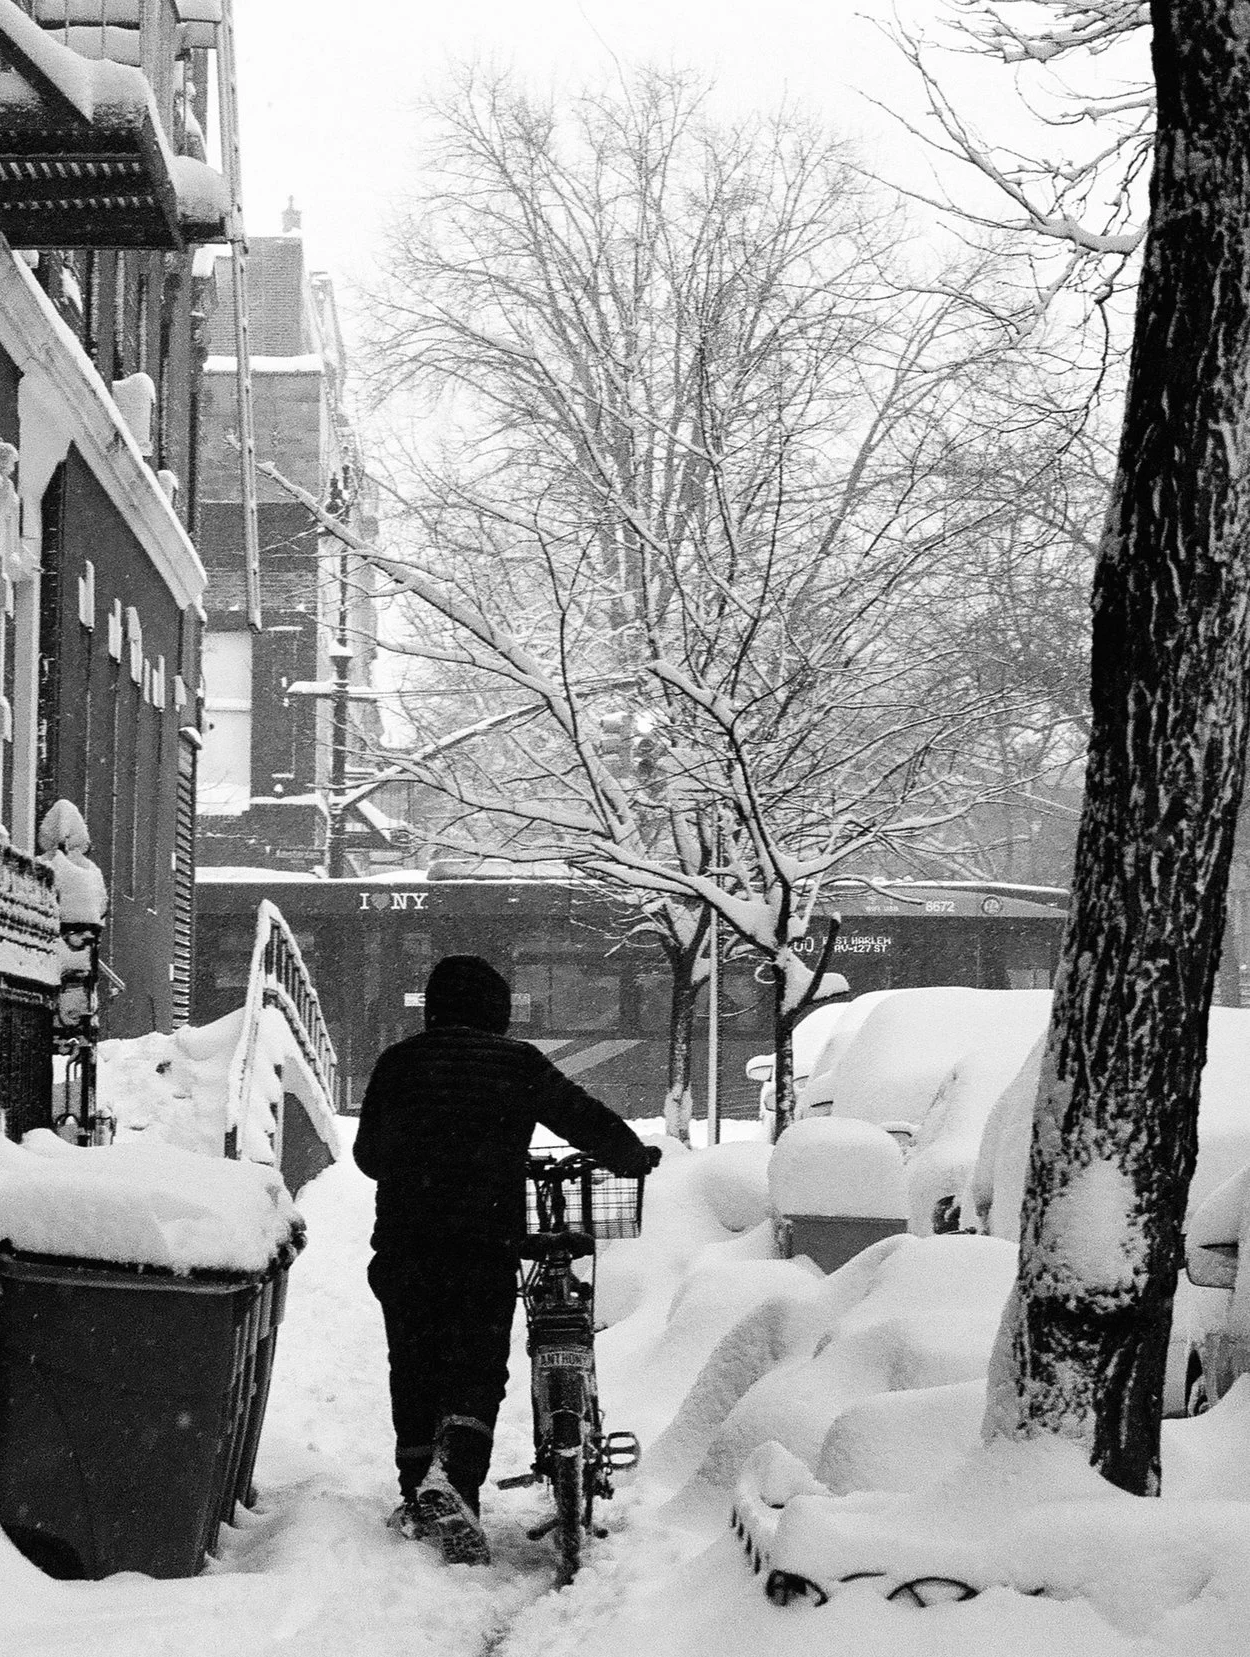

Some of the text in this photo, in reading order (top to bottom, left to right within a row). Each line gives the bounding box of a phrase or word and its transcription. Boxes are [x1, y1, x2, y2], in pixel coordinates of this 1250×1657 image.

[359, 892, 429, 910] I NY
[925, 901, 956, 912] 8672
[822, 936, 892, 945] EST HARLEM
[874, 944, 888, 953] ST
